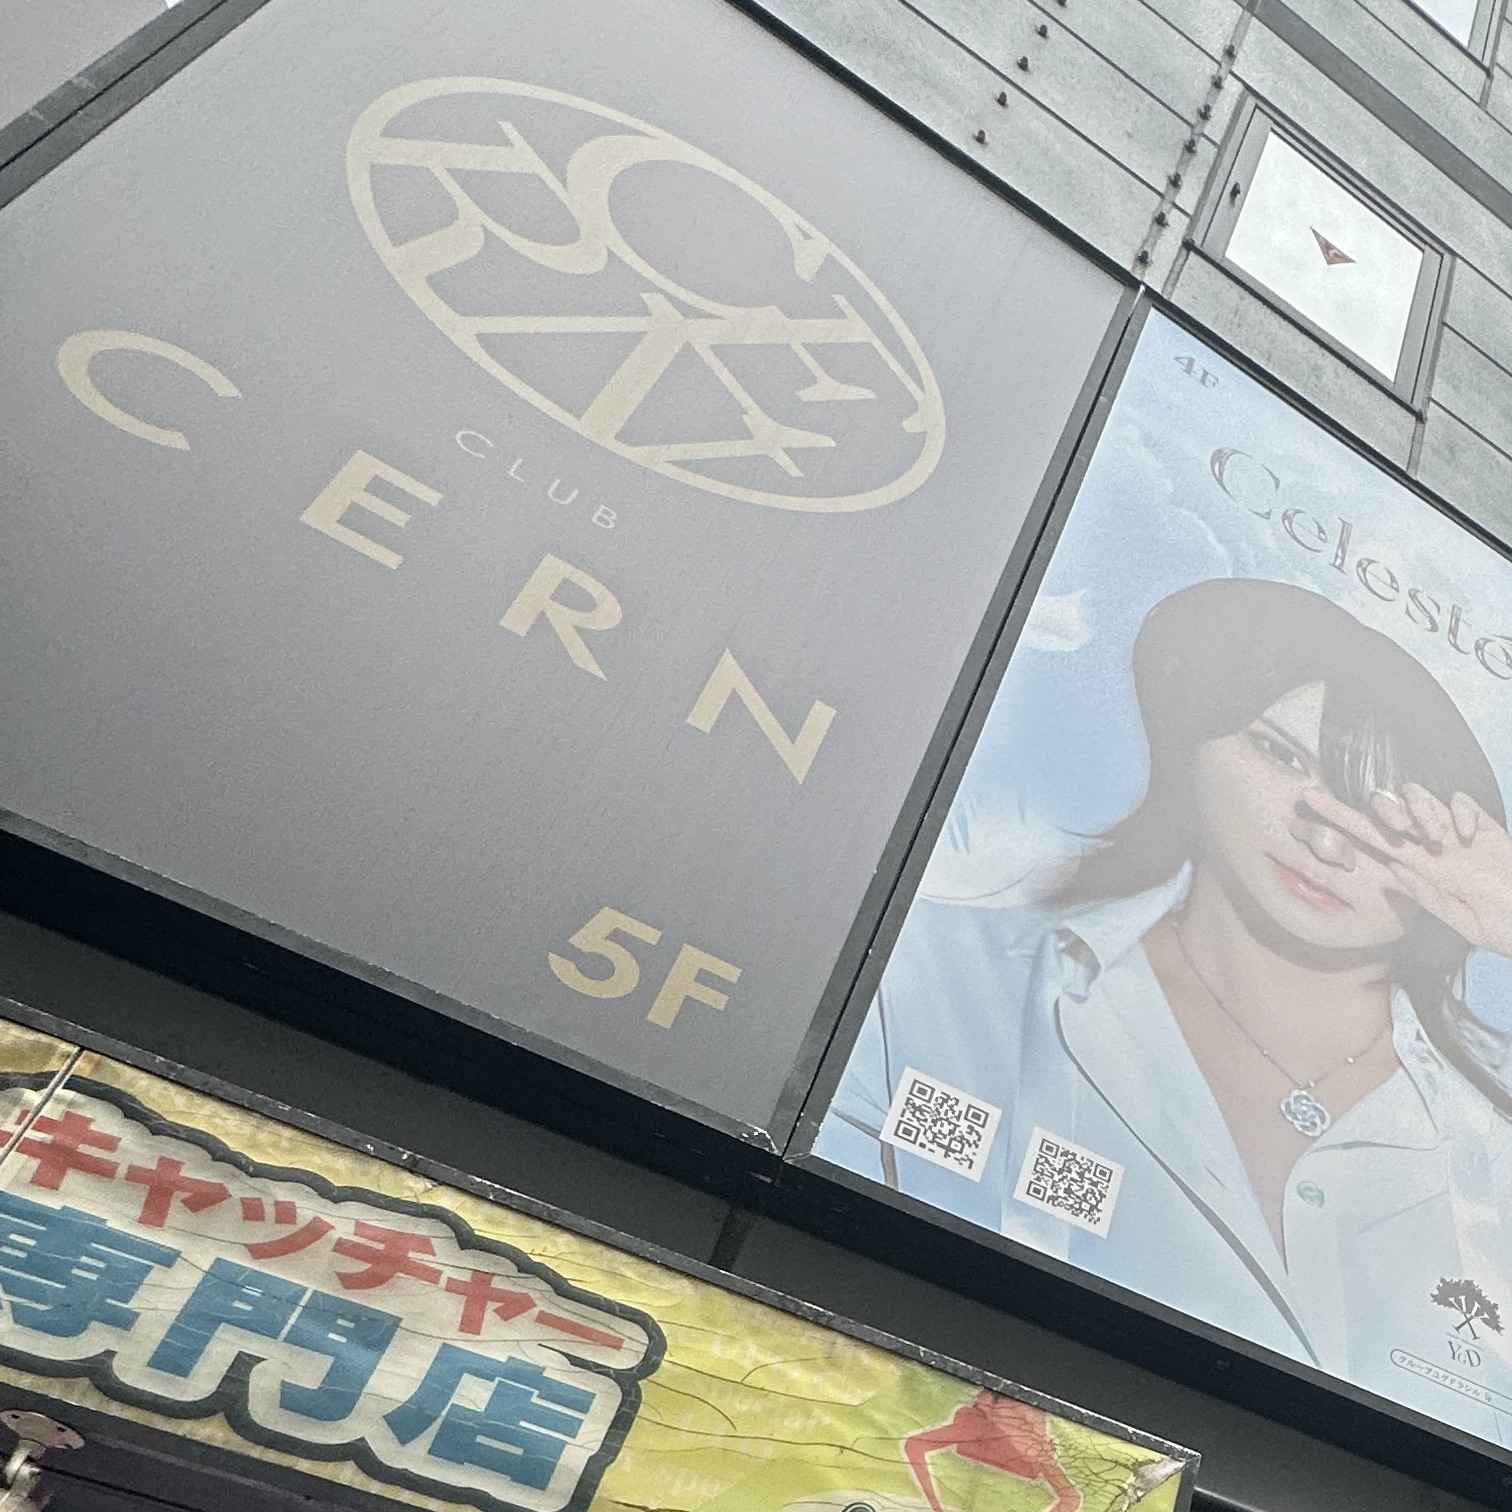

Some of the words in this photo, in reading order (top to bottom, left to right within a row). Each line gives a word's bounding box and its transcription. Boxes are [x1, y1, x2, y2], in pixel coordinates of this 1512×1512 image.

[1172, 353, 1221, 392] 4F
[56, 329, 837, 785] CERN
[455, 428, 619, 530] CLUB
[547, 909, 743, 1029] 5F
[0, 1107, 625, 1353] キャッチャー
[0, 1188, 597, 1492] 専門店
